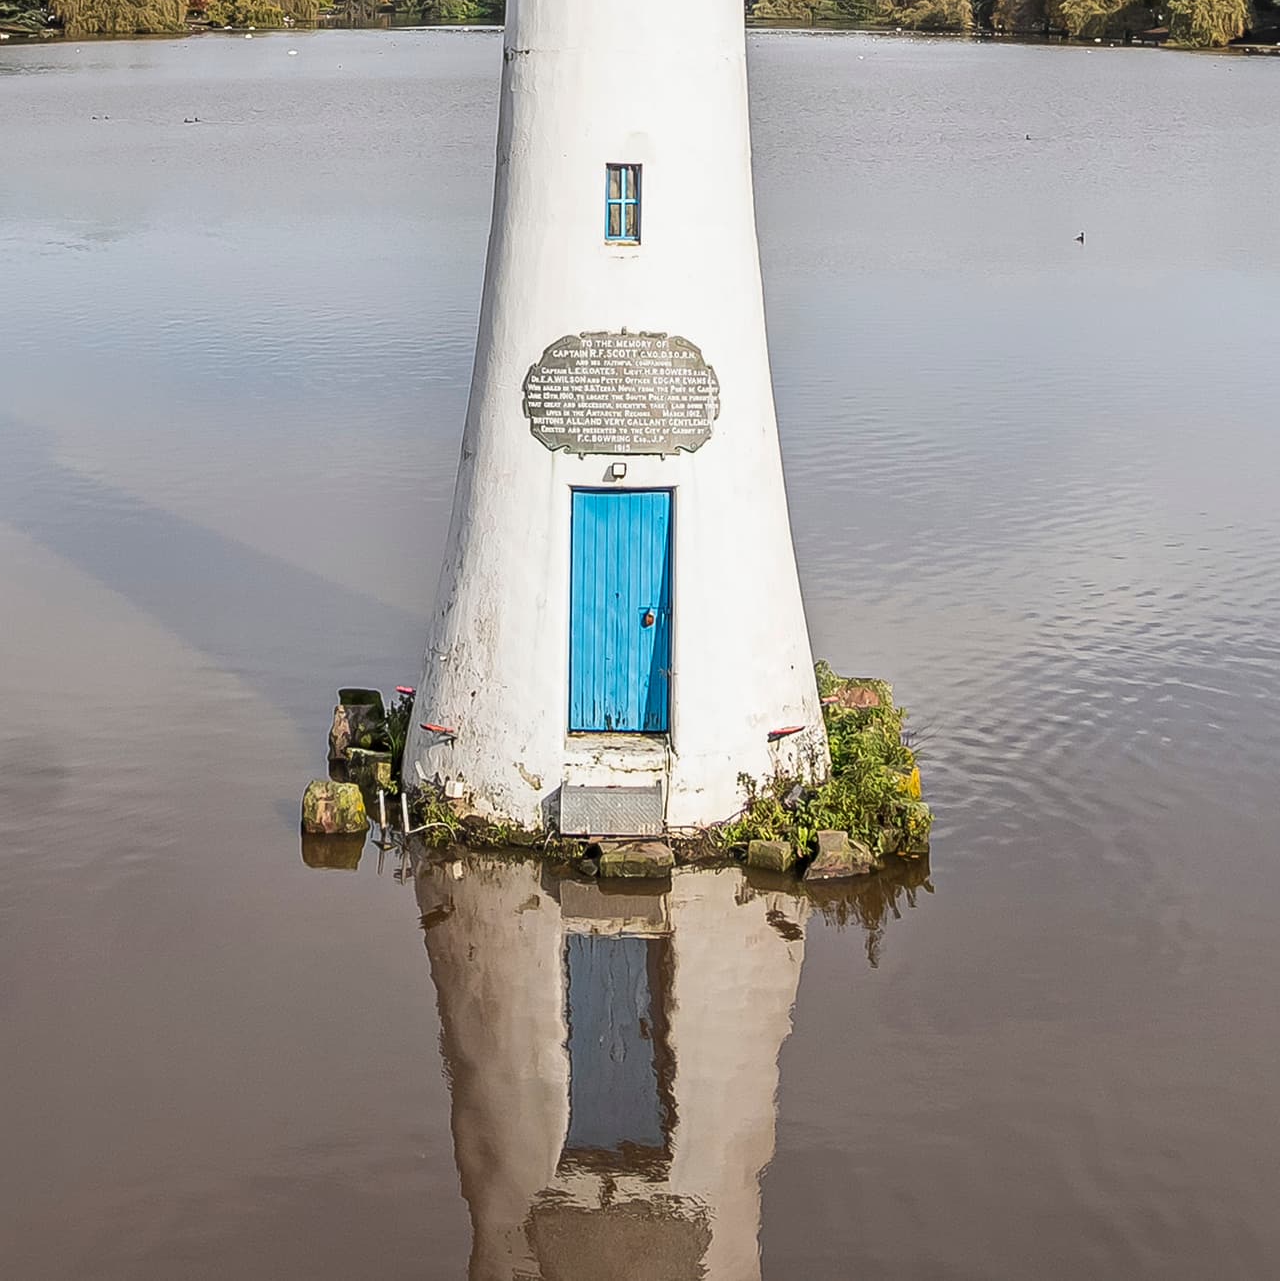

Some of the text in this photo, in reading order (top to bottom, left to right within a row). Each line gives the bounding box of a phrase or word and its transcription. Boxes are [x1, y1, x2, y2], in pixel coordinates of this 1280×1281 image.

[581, 339, 667, 348] TO THE MEMORY OF
[552, 350, 588, 358] CAPTAIN
[653, 377, 680, 385] EDGAR
[604, 418, 625, 426] VERY
[627, 418, 666, 426] GALLANT
